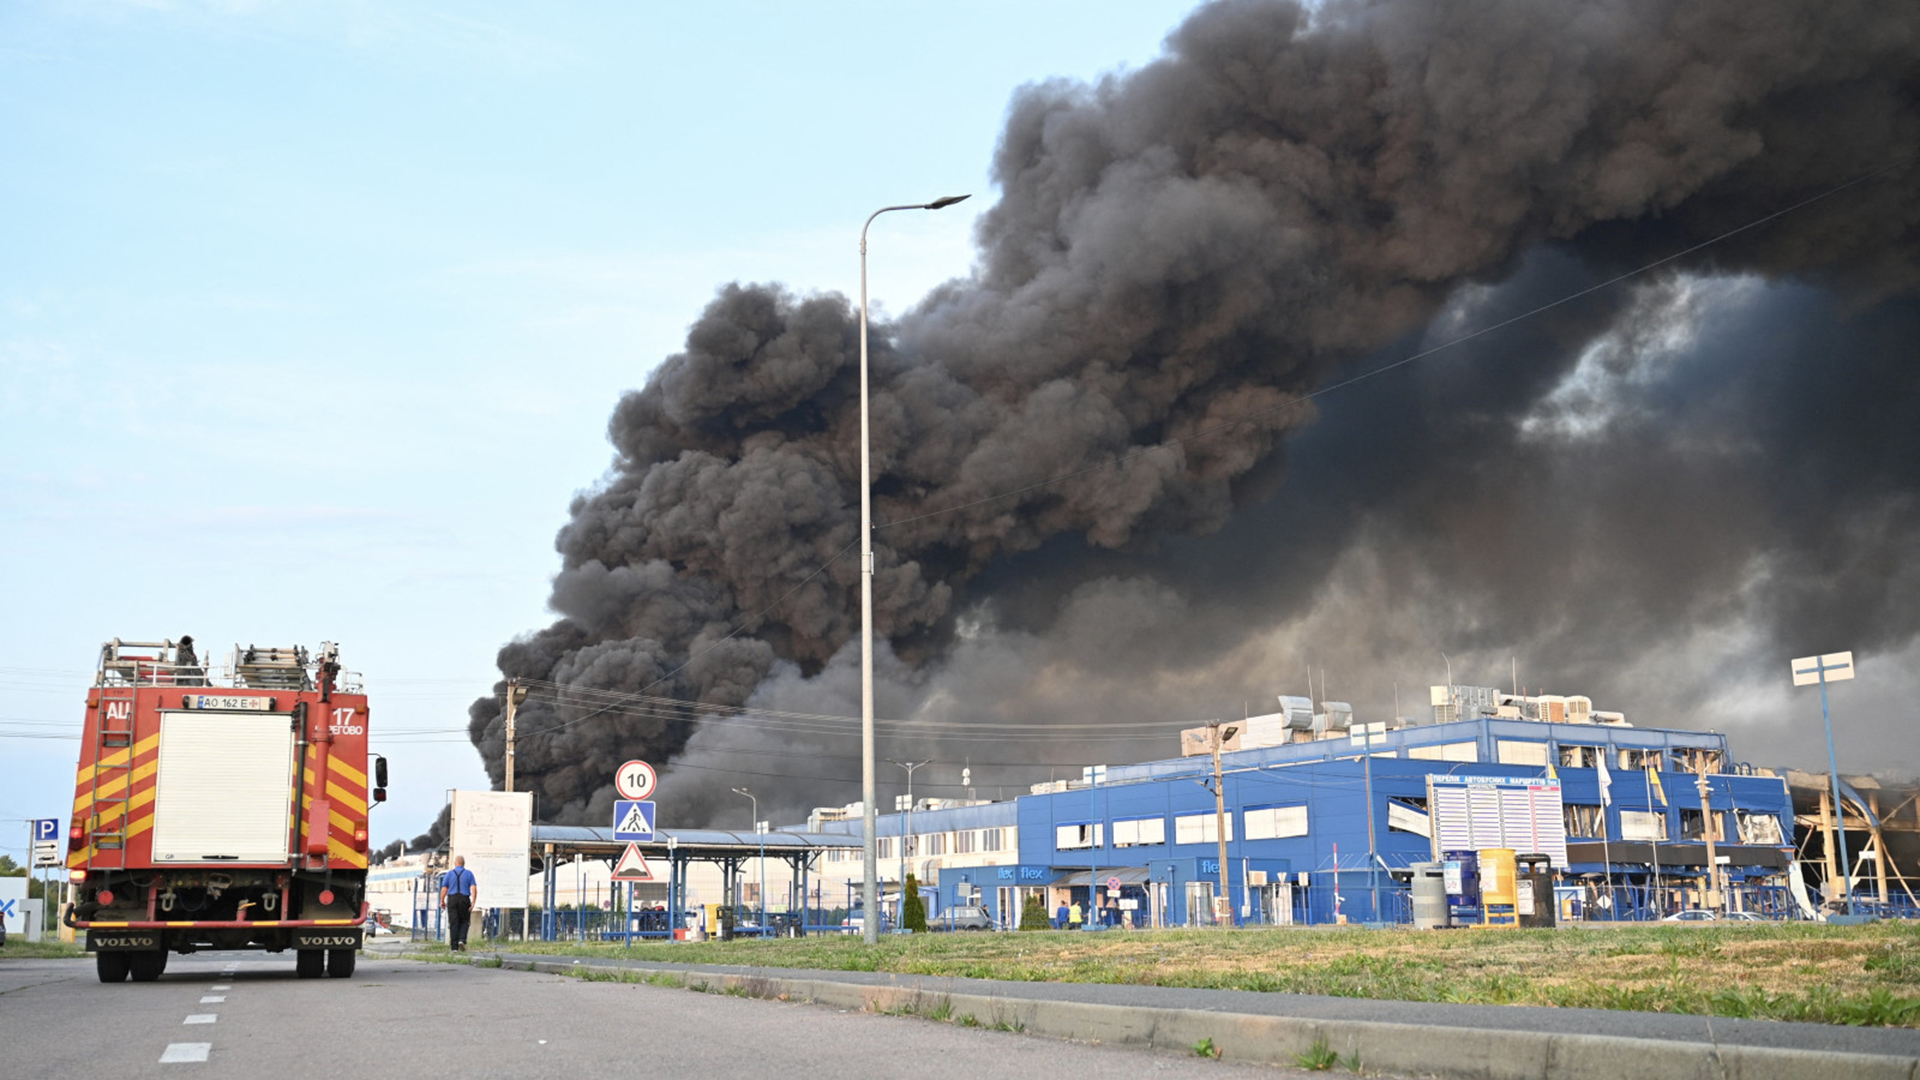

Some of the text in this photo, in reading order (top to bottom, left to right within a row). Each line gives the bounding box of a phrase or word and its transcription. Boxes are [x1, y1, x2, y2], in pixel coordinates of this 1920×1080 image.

[204, 698, 248, 708] AO 162 E
[332, 708, 355, 725] 17
[627, 773, 647, 788] 10
[41, 821, 54, 839] P
[998, 867, 1014, 879] flex
[1021, 867, 1043, 879] flex
[1202, 860, 1220, 874] fle
[94, 937, 154, 947] VOLVO
[300, 936, 355, 946] VOLVO
